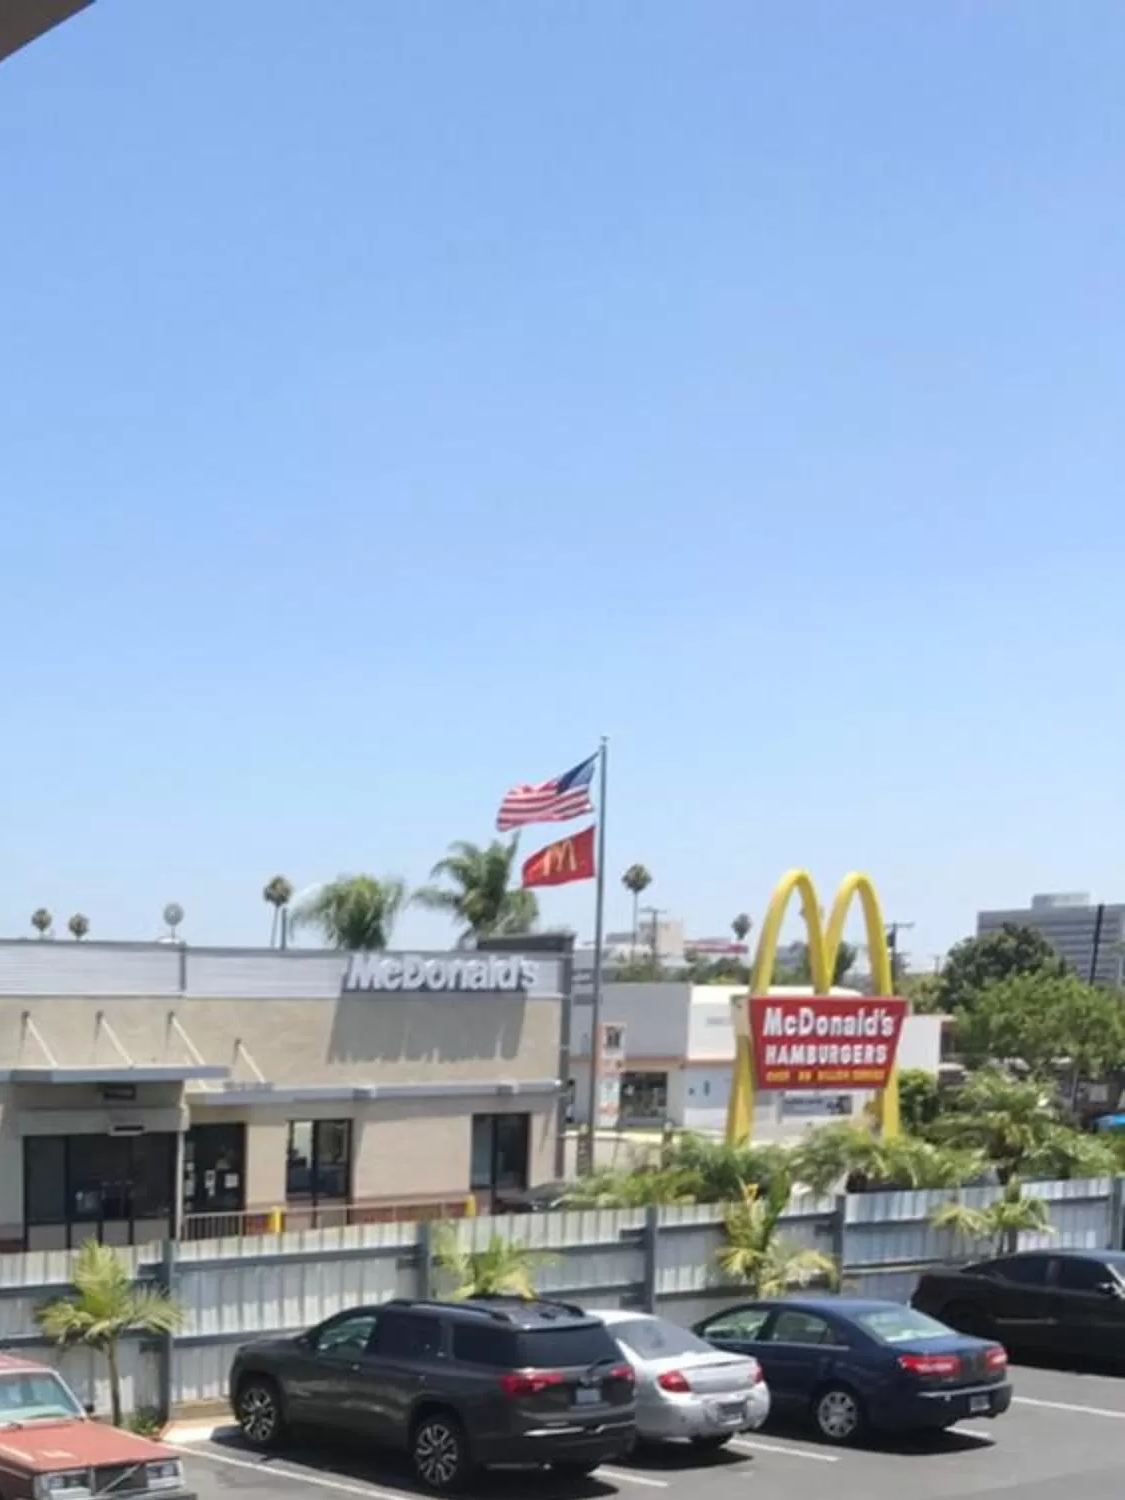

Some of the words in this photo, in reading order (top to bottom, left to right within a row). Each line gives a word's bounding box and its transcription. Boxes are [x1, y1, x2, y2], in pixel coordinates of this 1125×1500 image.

[345, 952, 541, 991] McDonald's
[764, 1008, 894, 1036] McDonald's
[766, 1045, 888, 1065] HAMBURGERS
